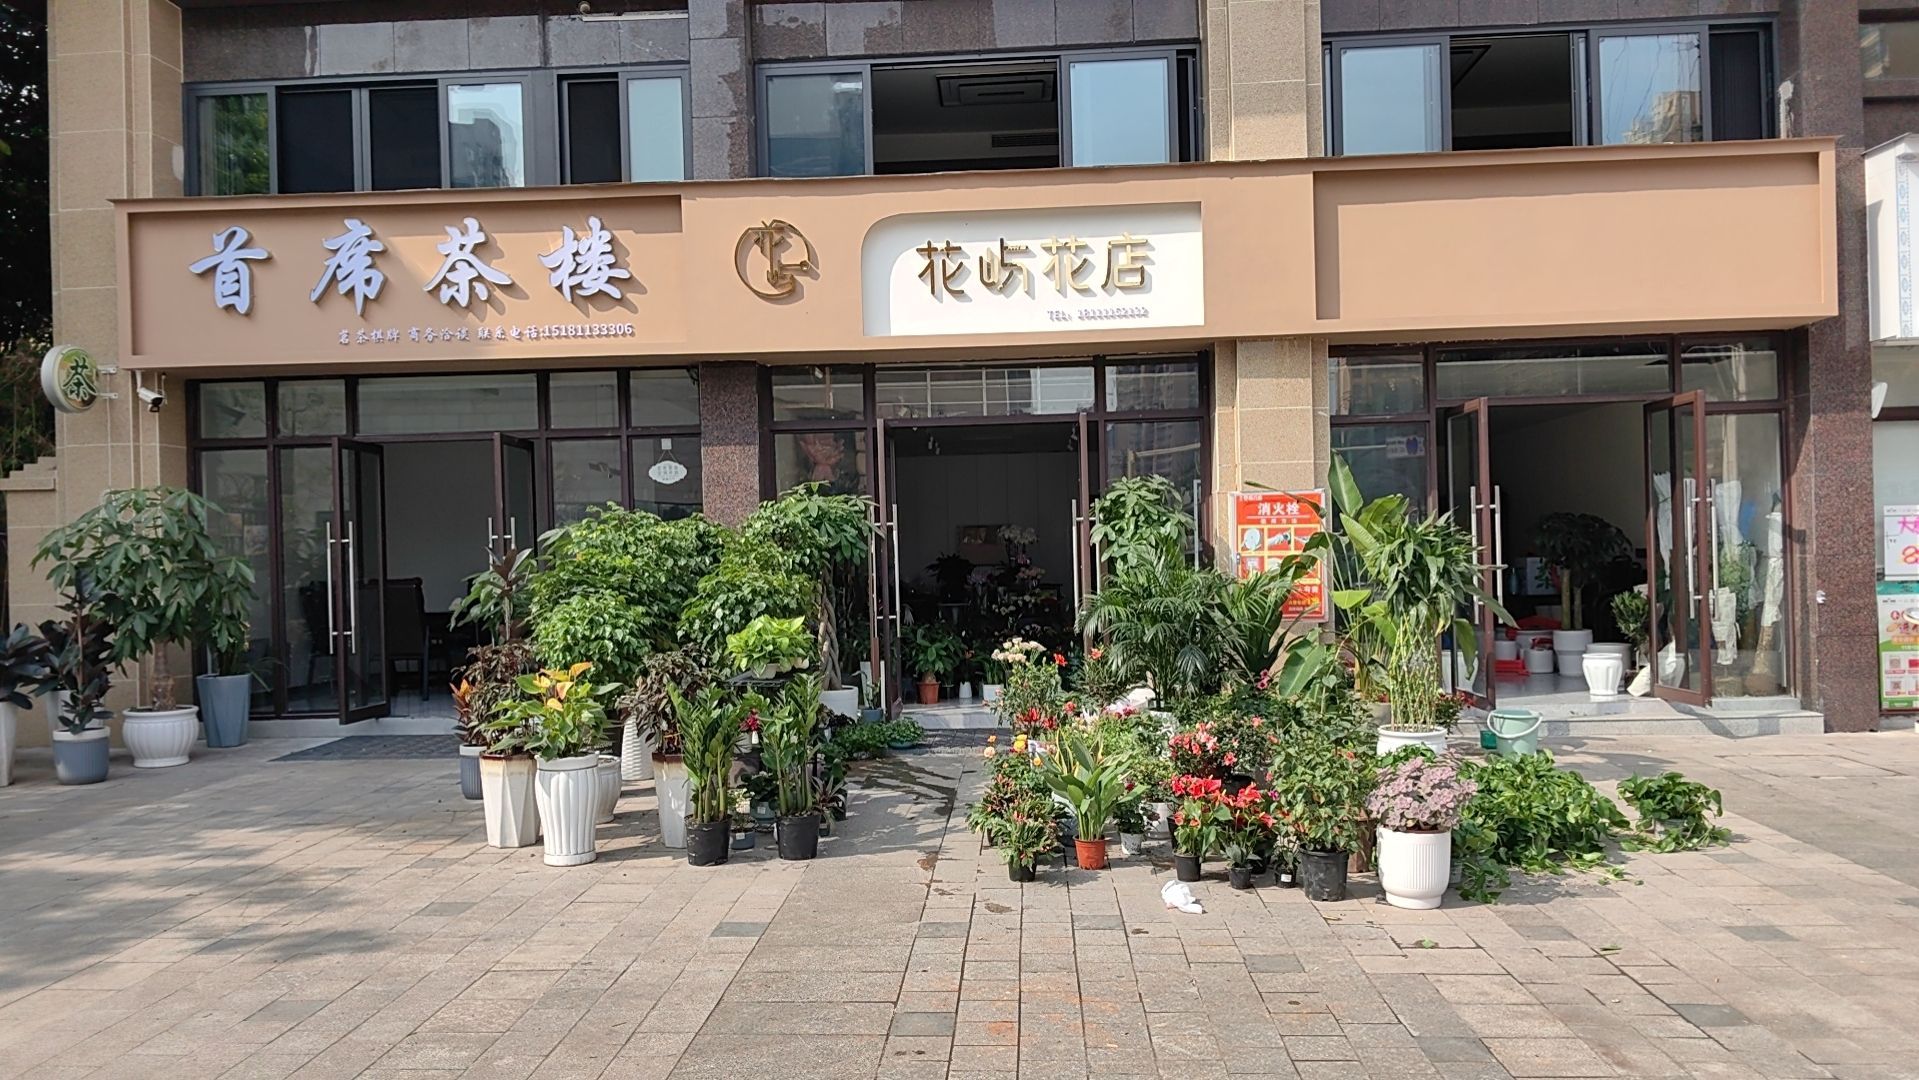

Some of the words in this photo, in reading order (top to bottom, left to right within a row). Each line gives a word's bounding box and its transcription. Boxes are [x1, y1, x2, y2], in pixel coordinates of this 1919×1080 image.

[188, 216, 632, 316] 首席茶楼
[914, 232, 1146, 295] 花屿花店
[408, 326, 470, 343] 商务洽谈
[61, 356, 97, 401] 茶
[1257, 501, 1300, 516] 消火栓
